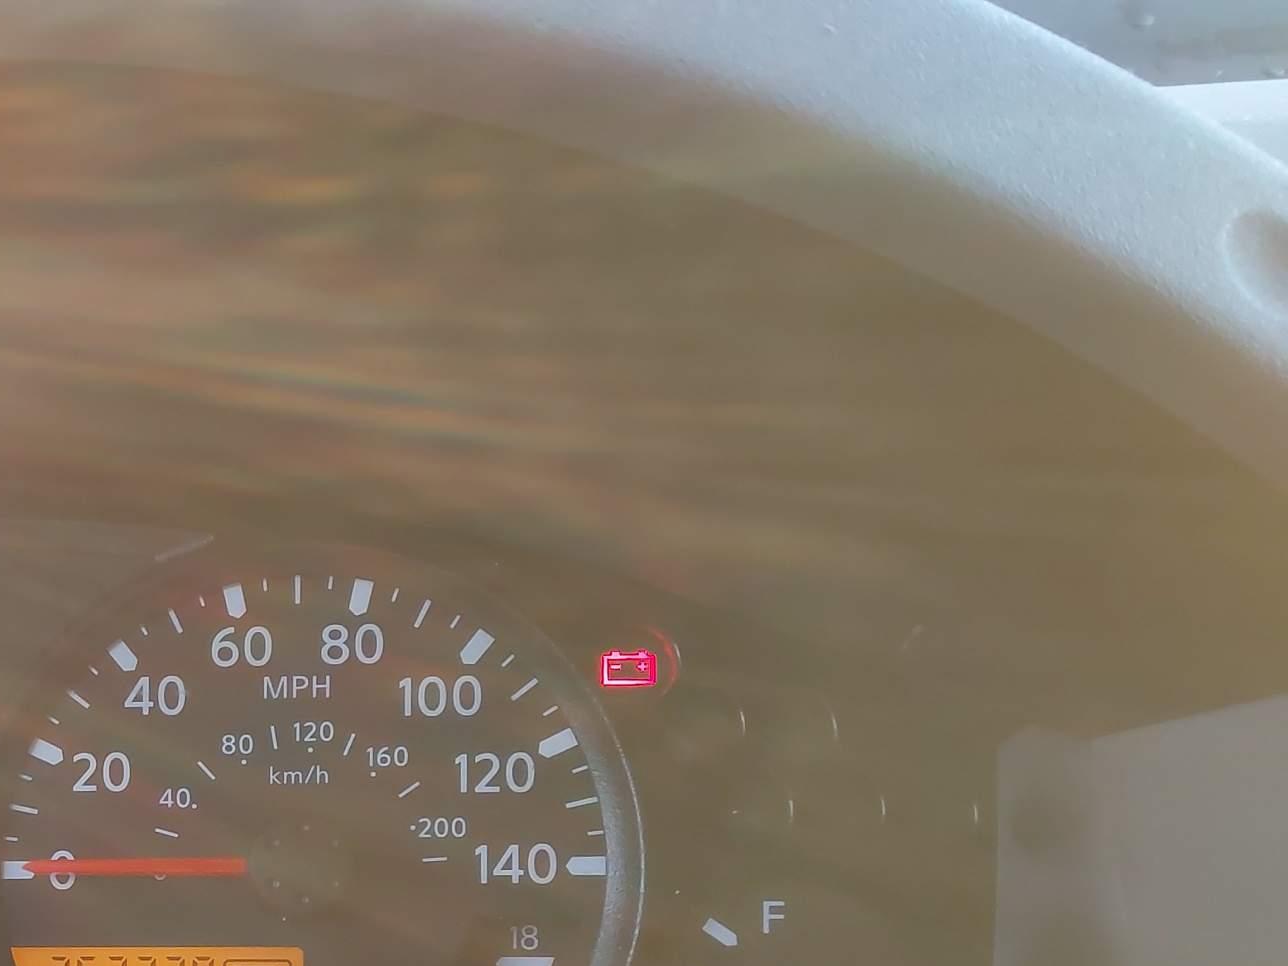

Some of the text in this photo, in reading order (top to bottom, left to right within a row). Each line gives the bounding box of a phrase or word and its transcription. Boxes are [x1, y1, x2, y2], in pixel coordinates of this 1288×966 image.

[212, 626, 272, 667] 60
[320, 623, 384, 665] 80
[124, 676, 186, 716] 40
[262, 675, 331, 699] MPH
[399, 675, 482, 717] 100
[221, 734, 253, 755] 80
[292, 721, 334, 742] 120
[72, 752, 131, 792] 20
[366, 746, 409, 767] 160
[455, 752, 535, 793] 120
[269, 766, 330, 786] km/h
[159, 788, 191, 808] 40
[418, 818, 467, 838] 200
[474, 843, 558, 884] 140
[762, 901, 786, 934] F
